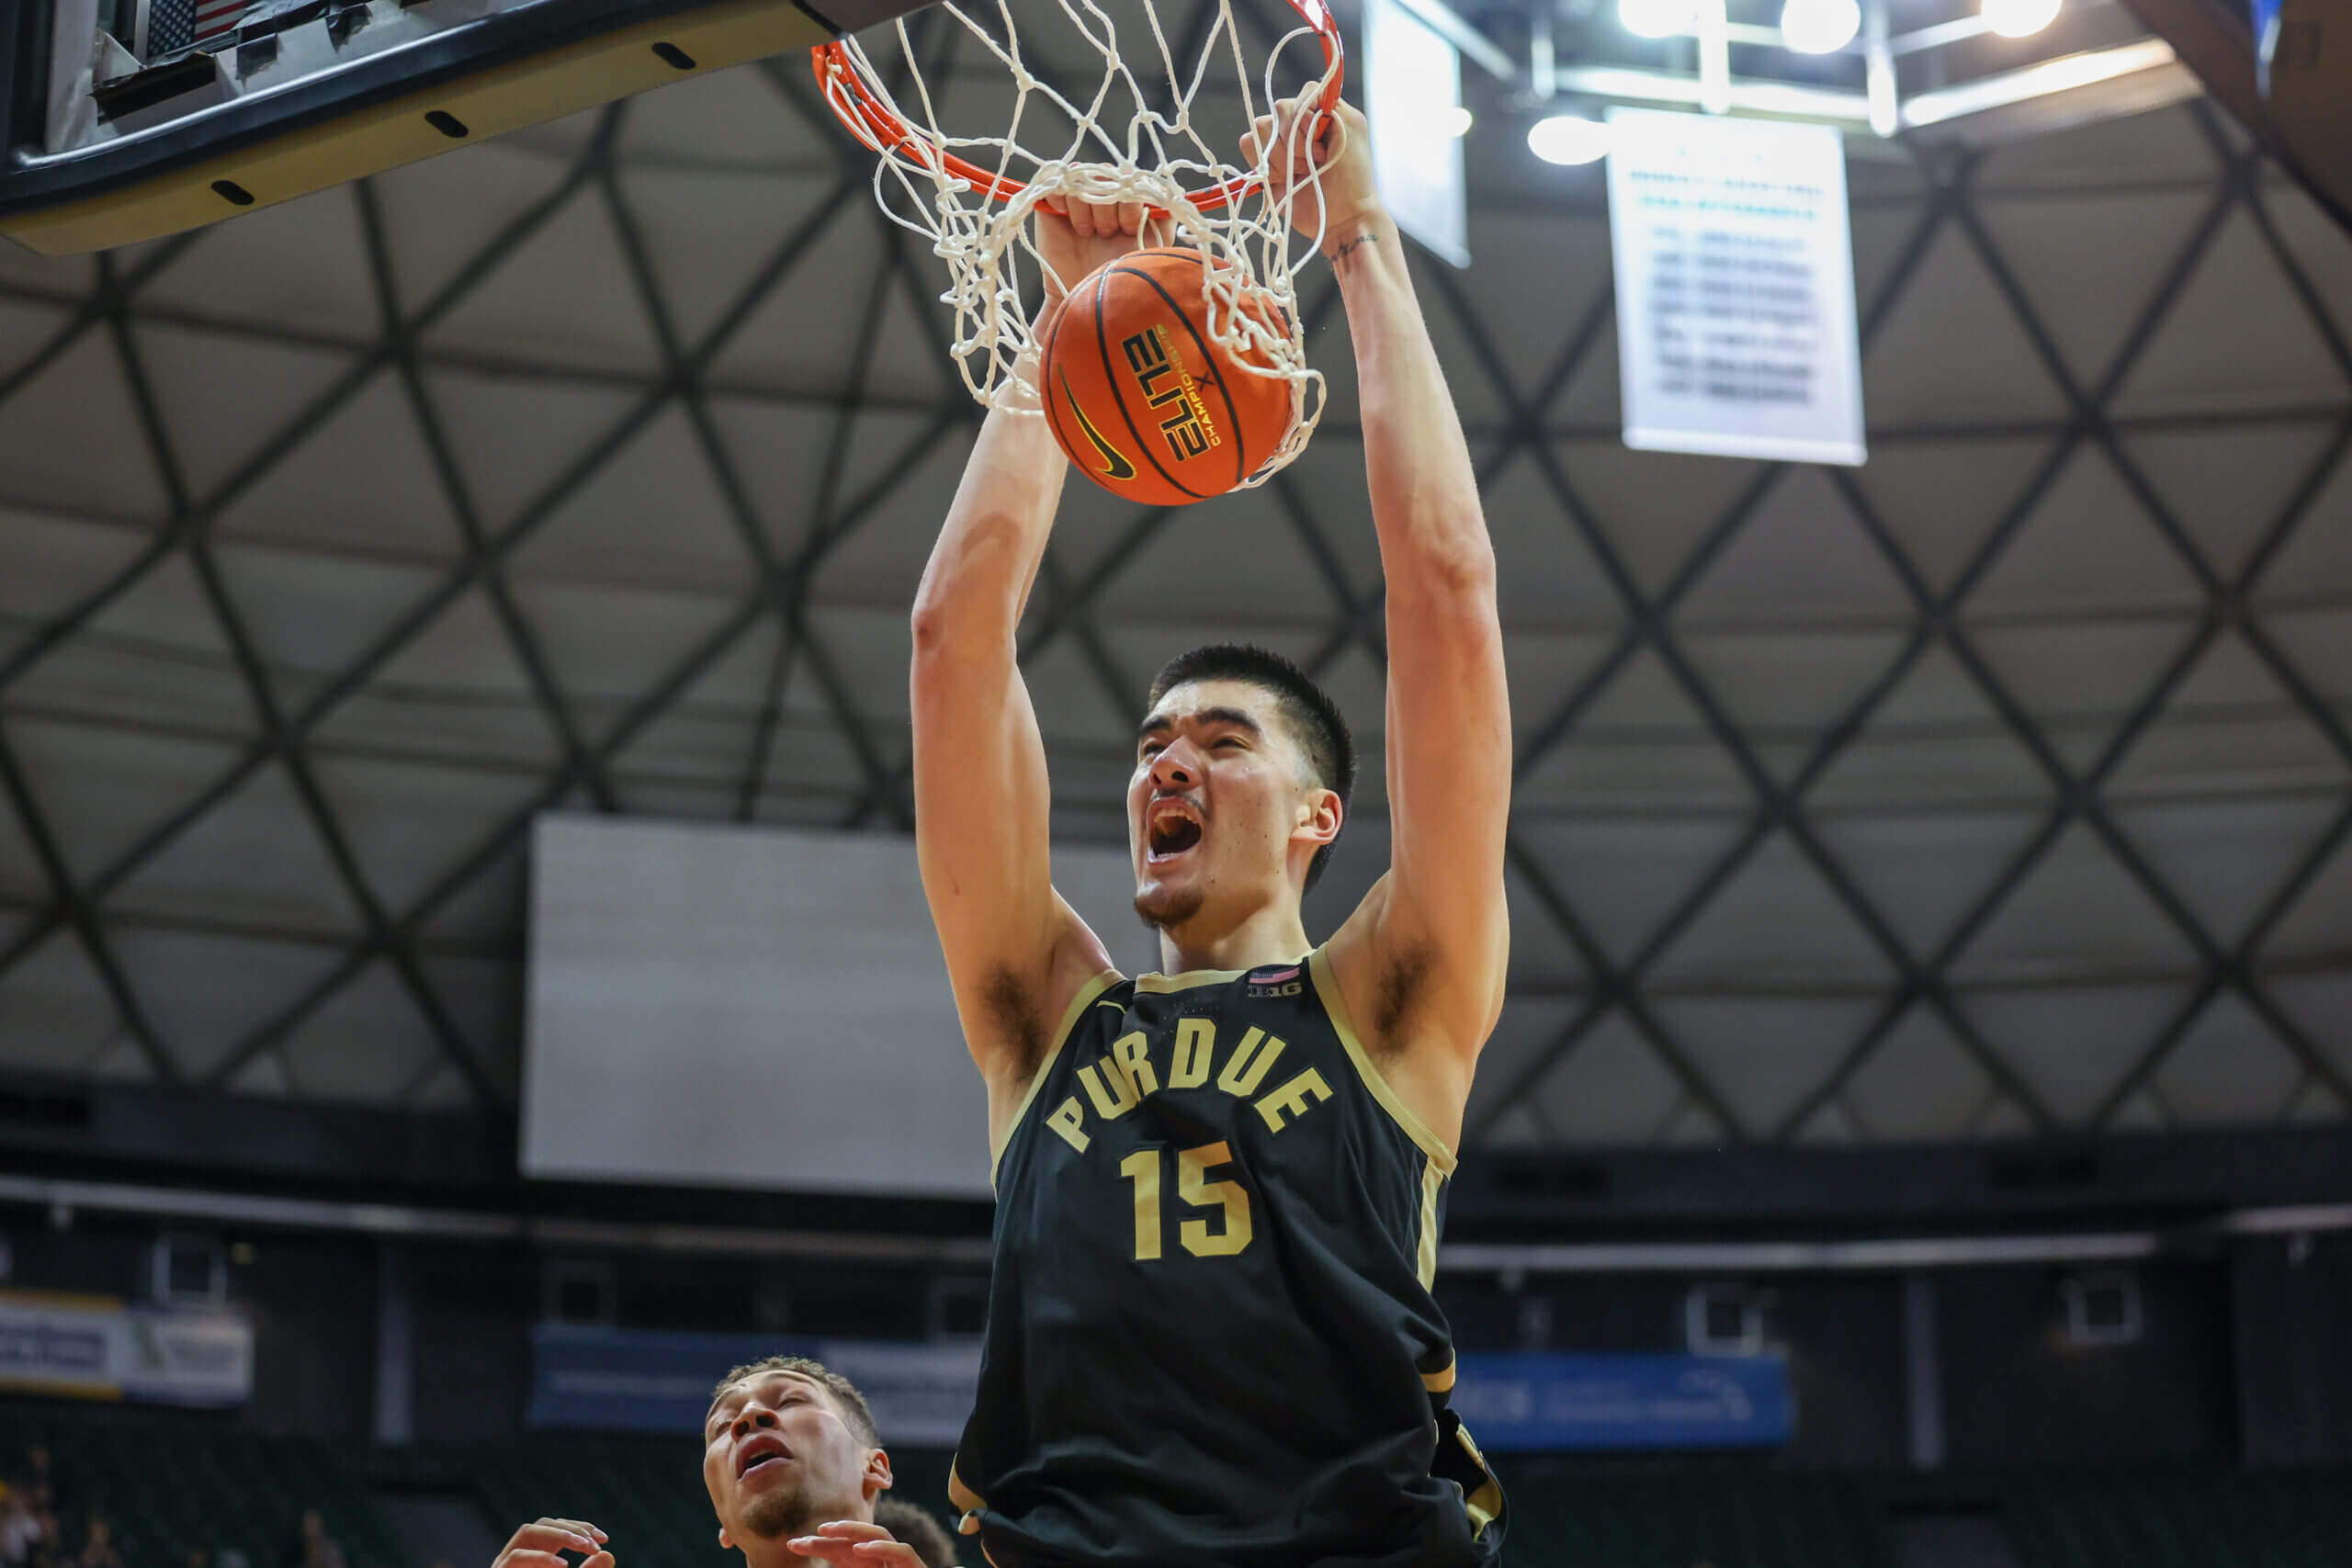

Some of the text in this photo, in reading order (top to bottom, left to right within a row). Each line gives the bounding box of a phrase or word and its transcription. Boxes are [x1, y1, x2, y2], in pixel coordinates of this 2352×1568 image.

[1122, 328, 1212, 461] ELITE
[1045, 1017, 1334, 1154] PURDUE
[1119, 1140, 1253, 1260] 15
